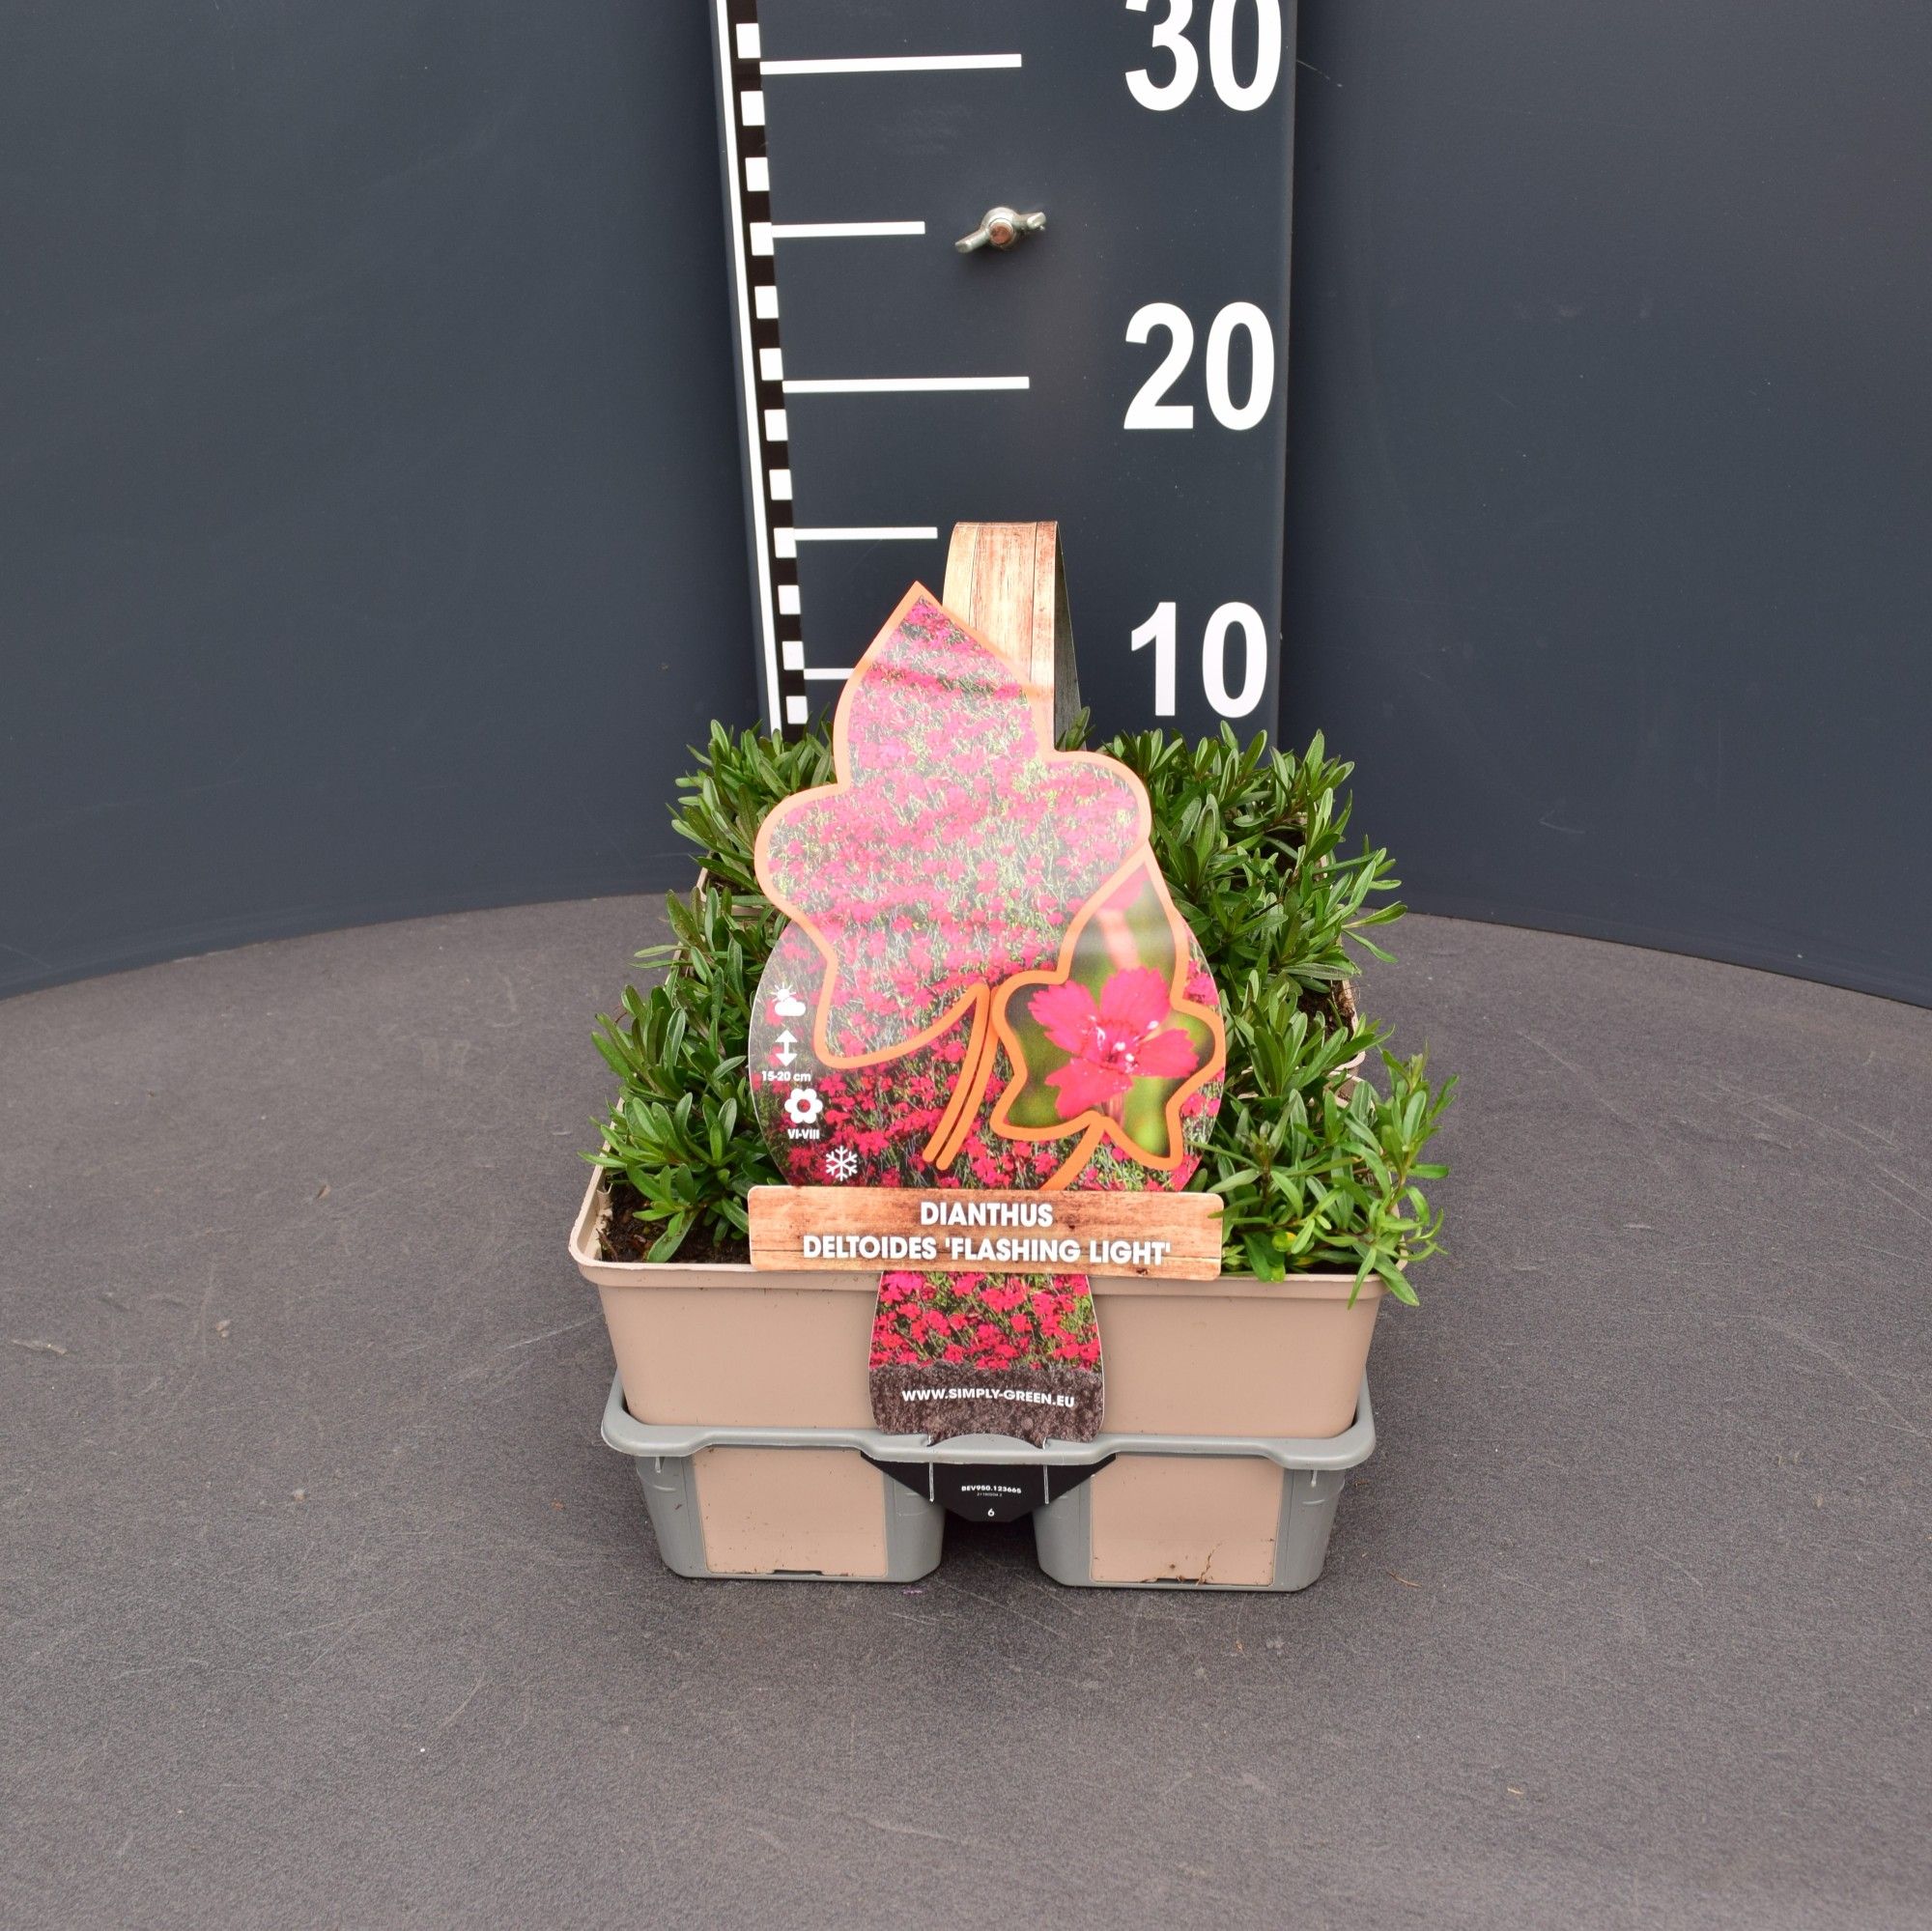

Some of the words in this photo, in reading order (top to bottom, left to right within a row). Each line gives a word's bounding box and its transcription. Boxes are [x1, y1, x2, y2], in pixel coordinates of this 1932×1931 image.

[1125, 0, 1282, 112] 30
[1123, 302, 1275, 431] 20
[1131, 601, 1268, 719] 10
[761, 1070, 791, 1081] 15-20
[792, 1073, 811, 1082] cm
[787, 1128, 819, 1140] VI-VIII
[920, 1202, 1053, 1228] DIANTHUS
[803, 1235, 937, 1259] DELTOIDES
[946, 1237, 1081, 1263] 'FLASHING
[1089, 1240, 1172, 1265] LIGHT'
[902, 1388, 1075, 1408] WWW.SIMPLY-GREEN.EU
[987, 1508, 995, 1518] 6
